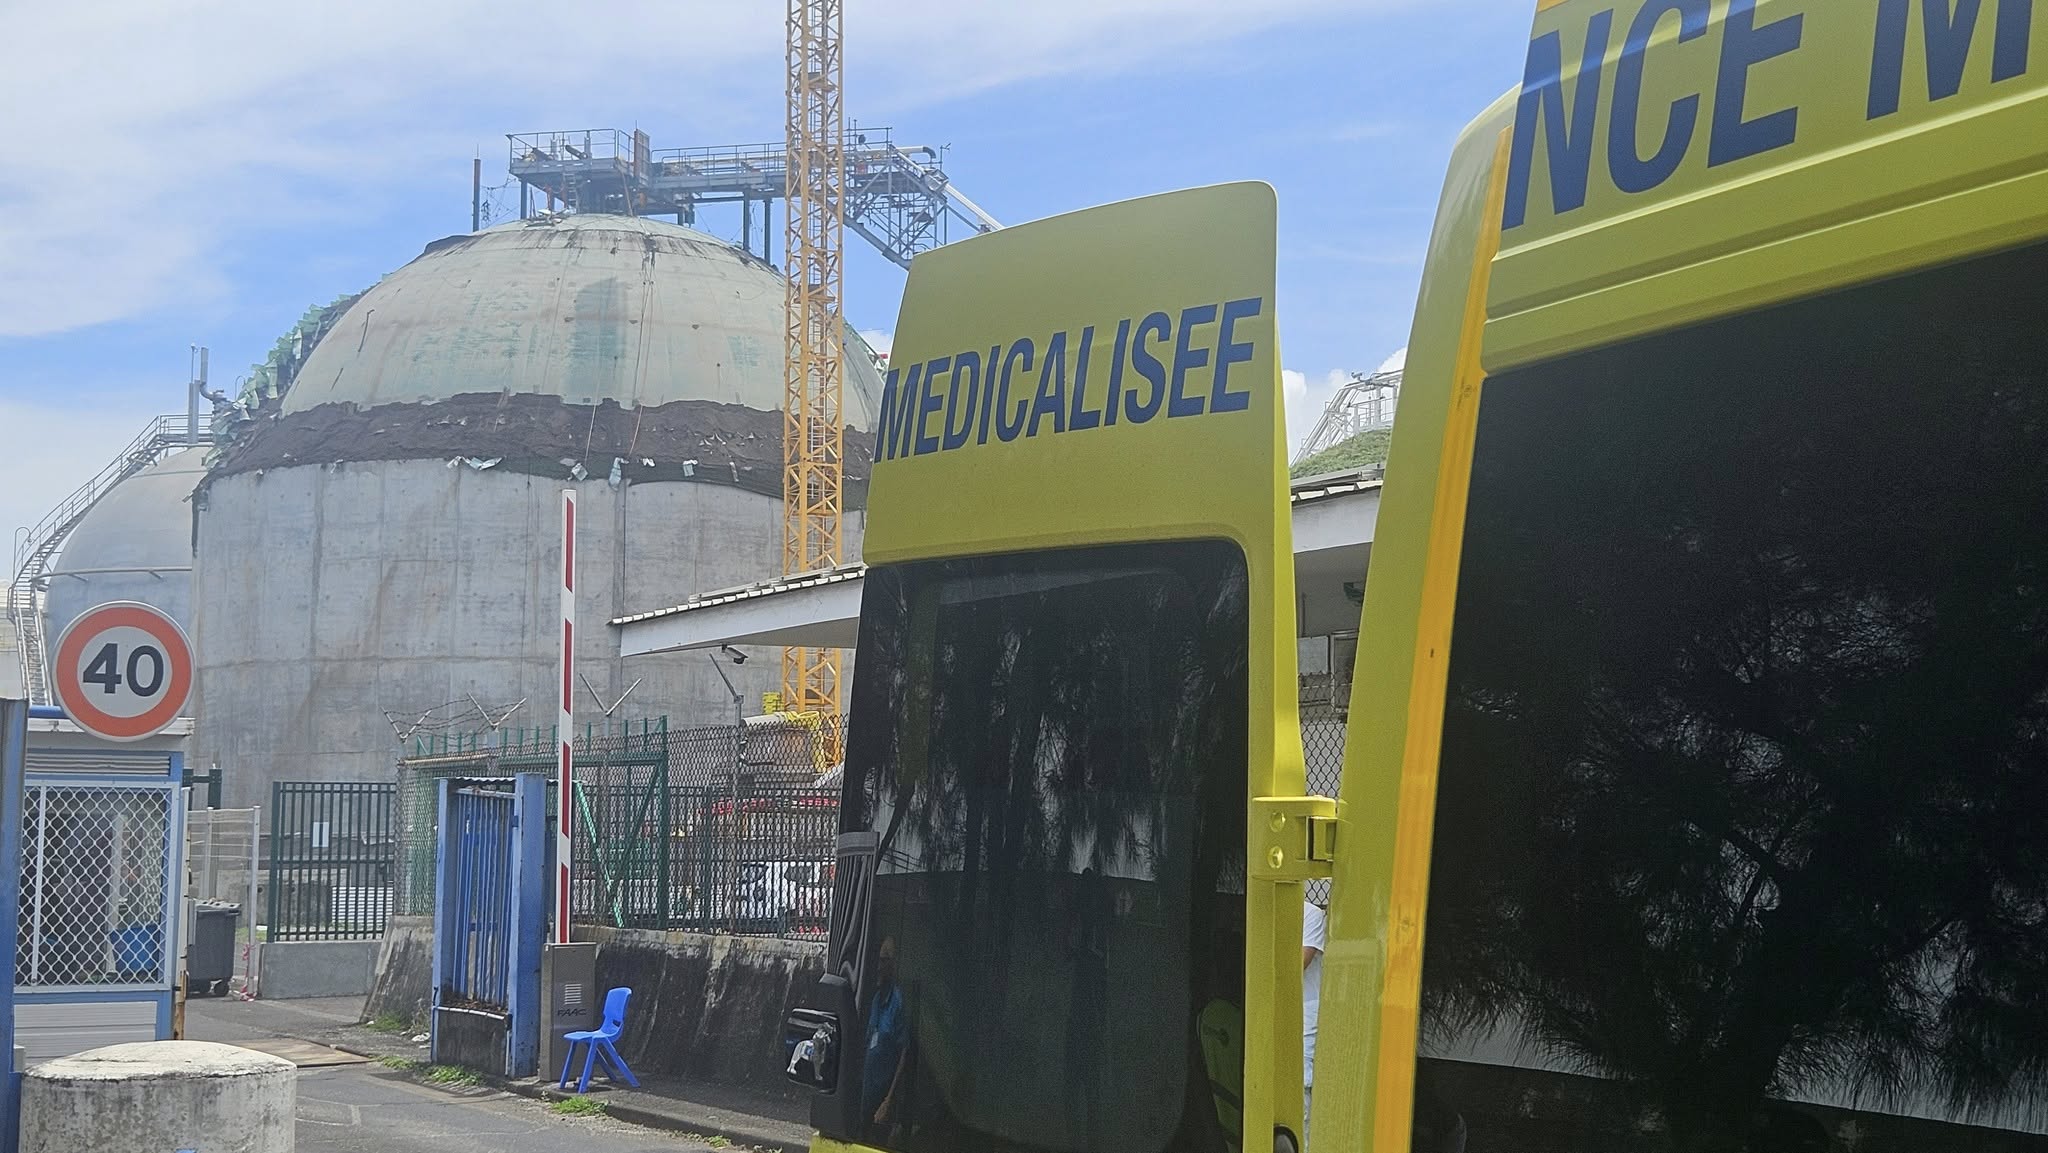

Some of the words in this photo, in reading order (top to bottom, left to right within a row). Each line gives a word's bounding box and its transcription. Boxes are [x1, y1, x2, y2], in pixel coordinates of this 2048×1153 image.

[874, 297, 1263, 463] MEDICALISEE
[83, 643, 164, 697] 40
[557, 1008, 587, 1017] FAAC
